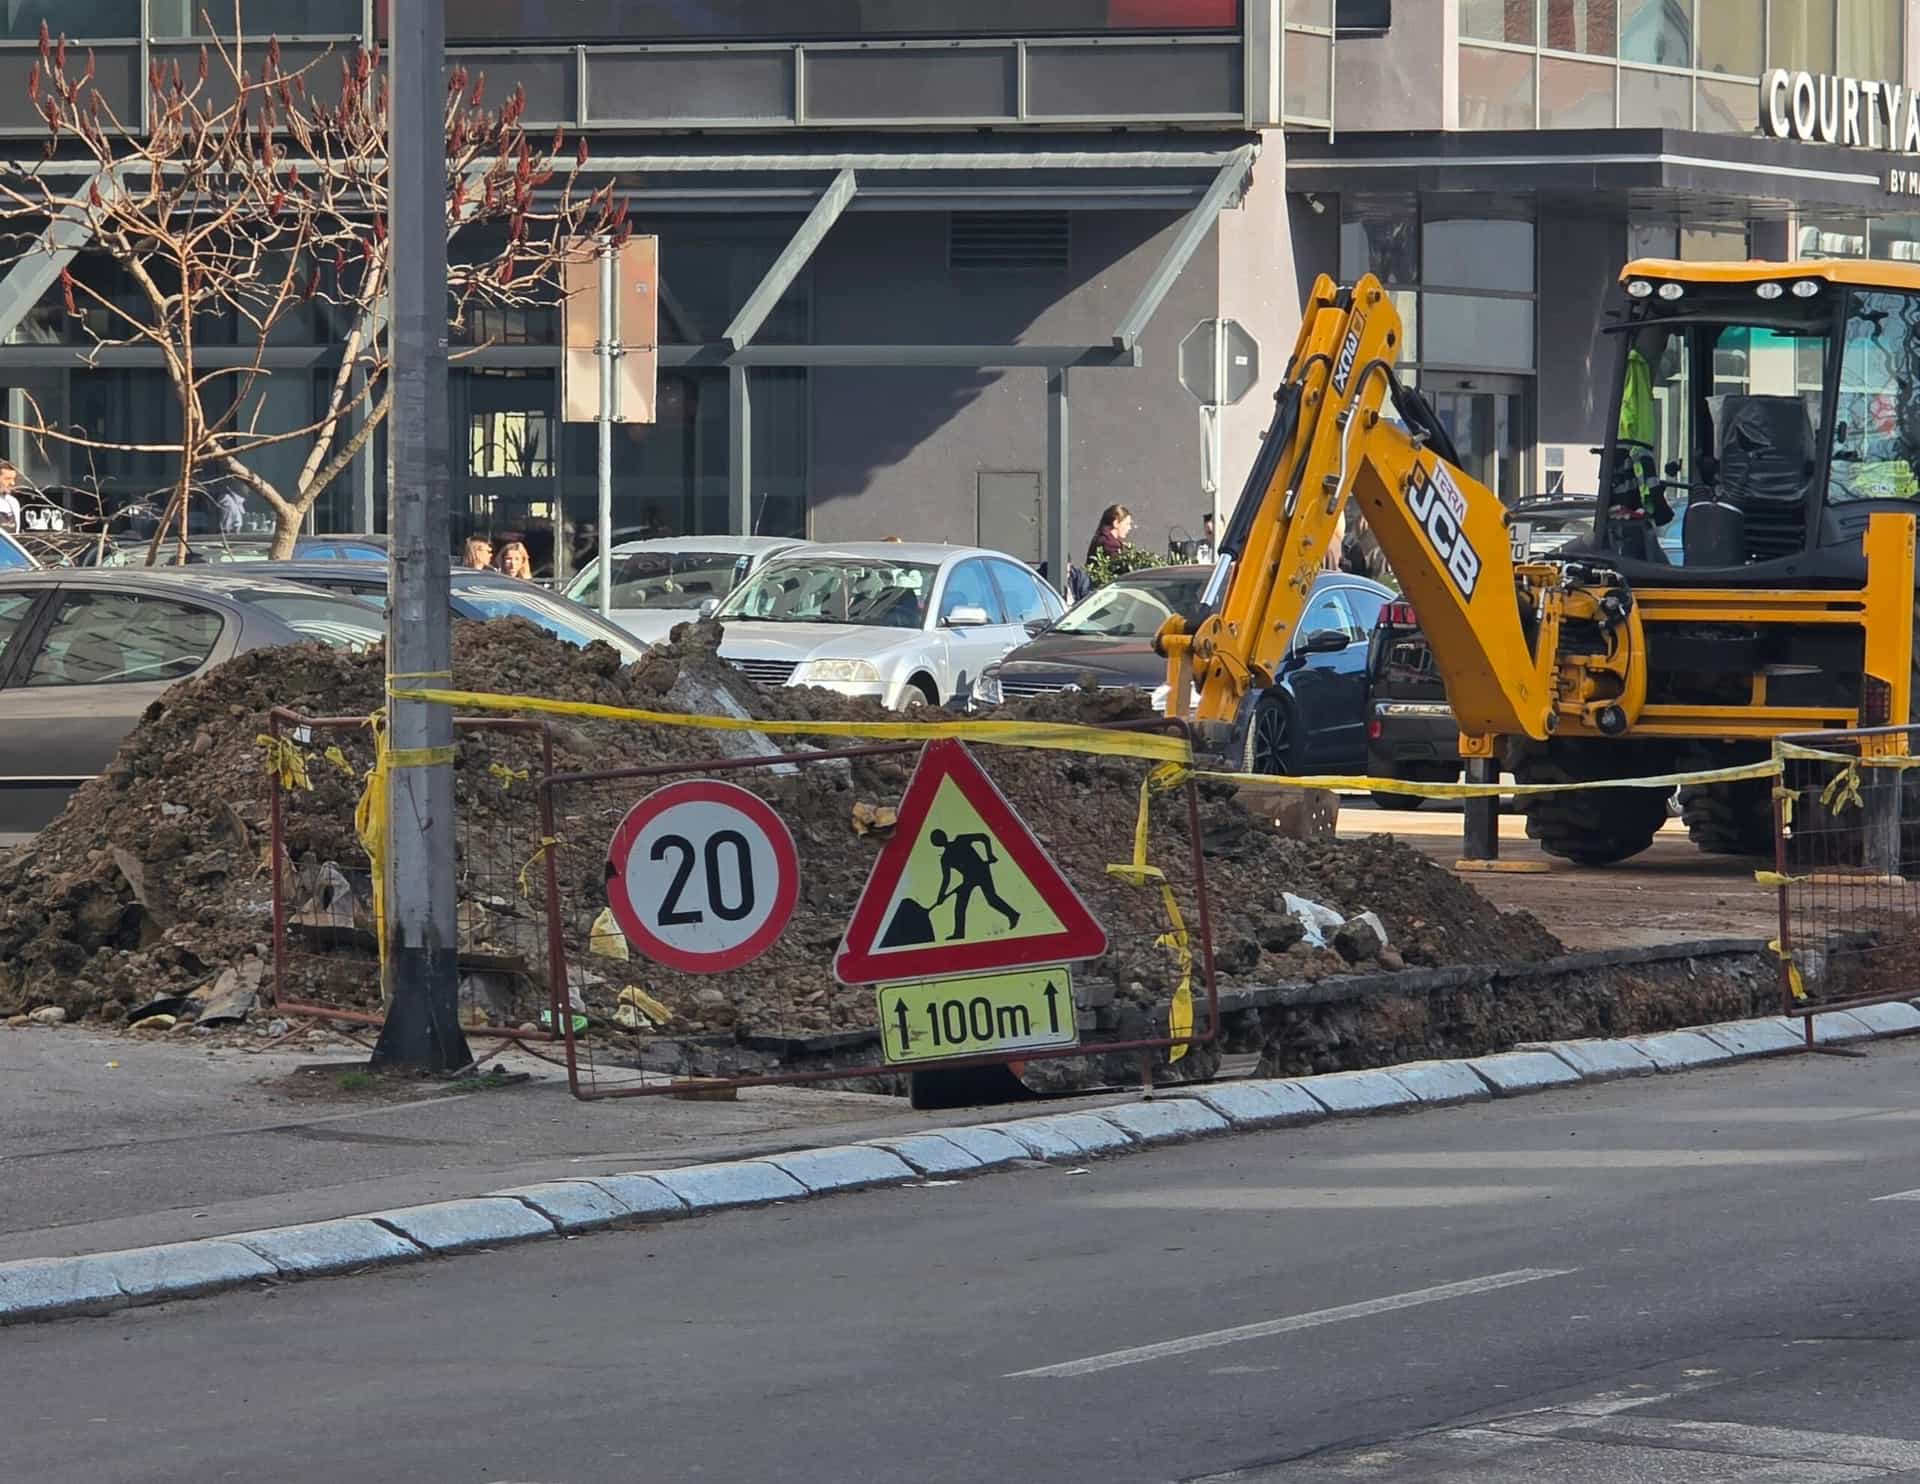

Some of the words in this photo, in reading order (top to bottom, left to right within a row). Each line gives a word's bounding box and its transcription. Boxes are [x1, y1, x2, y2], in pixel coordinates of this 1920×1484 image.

[1891, 169, 1905, 193] BY
[1408, 484, 1479, 595] JCB
[650, 830, 755, 926] 20
[926, 996, 1032, 1046] 100m
